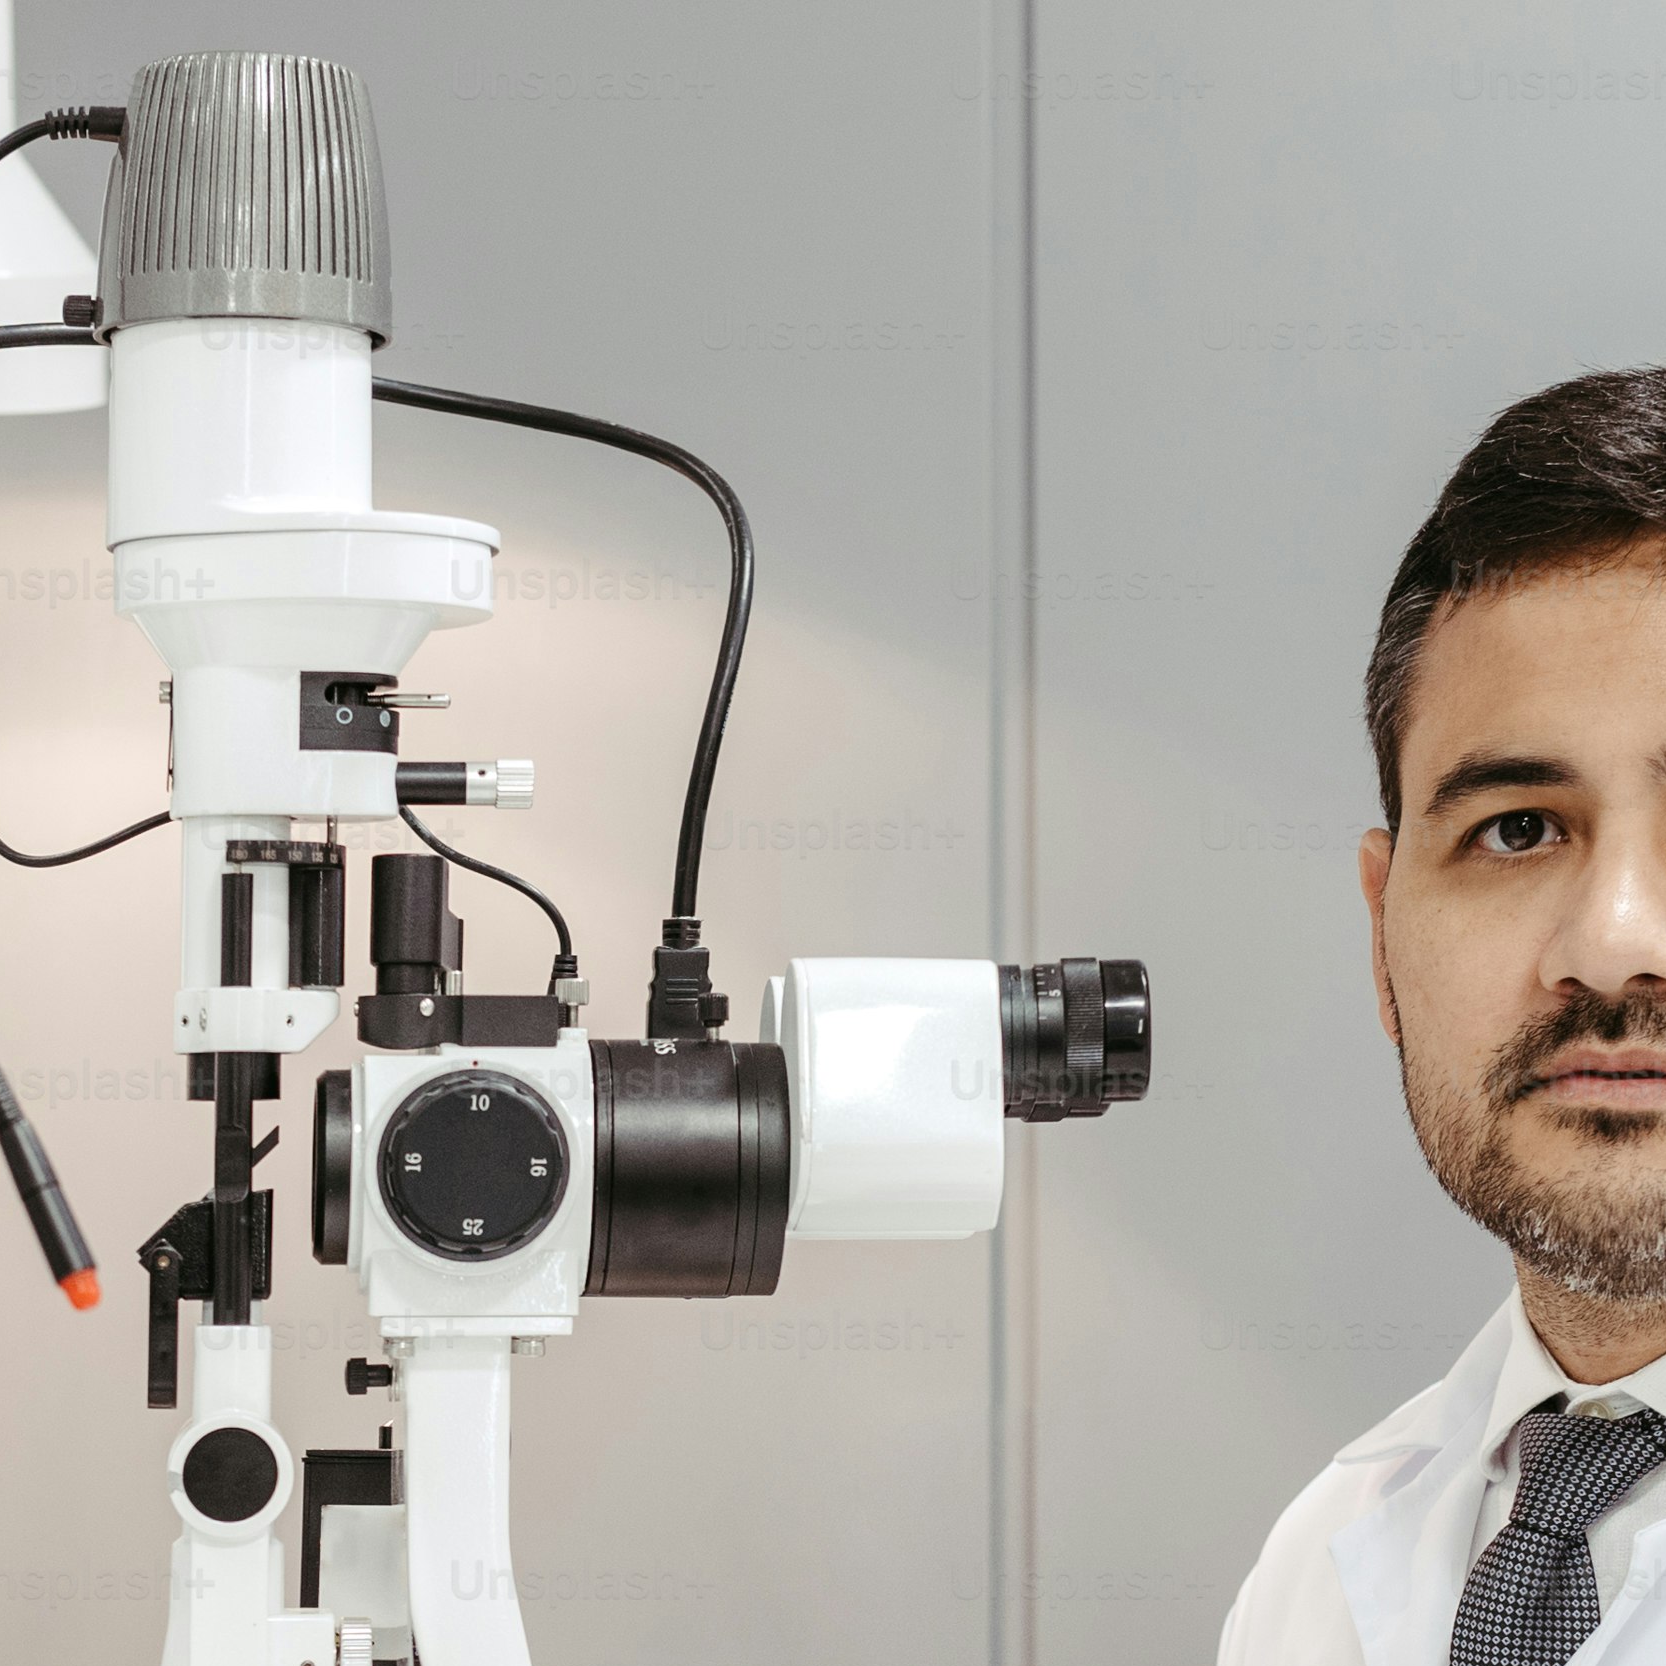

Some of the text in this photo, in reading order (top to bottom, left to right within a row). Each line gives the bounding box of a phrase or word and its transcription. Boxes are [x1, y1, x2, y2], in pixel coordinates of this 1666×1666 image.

[470, 1094, 490, 1111] 10
[405, 1152, 422, 1173] 16
[530, 1157, 548, 1177] 16
[462, 1218, 484, 1236] 25
